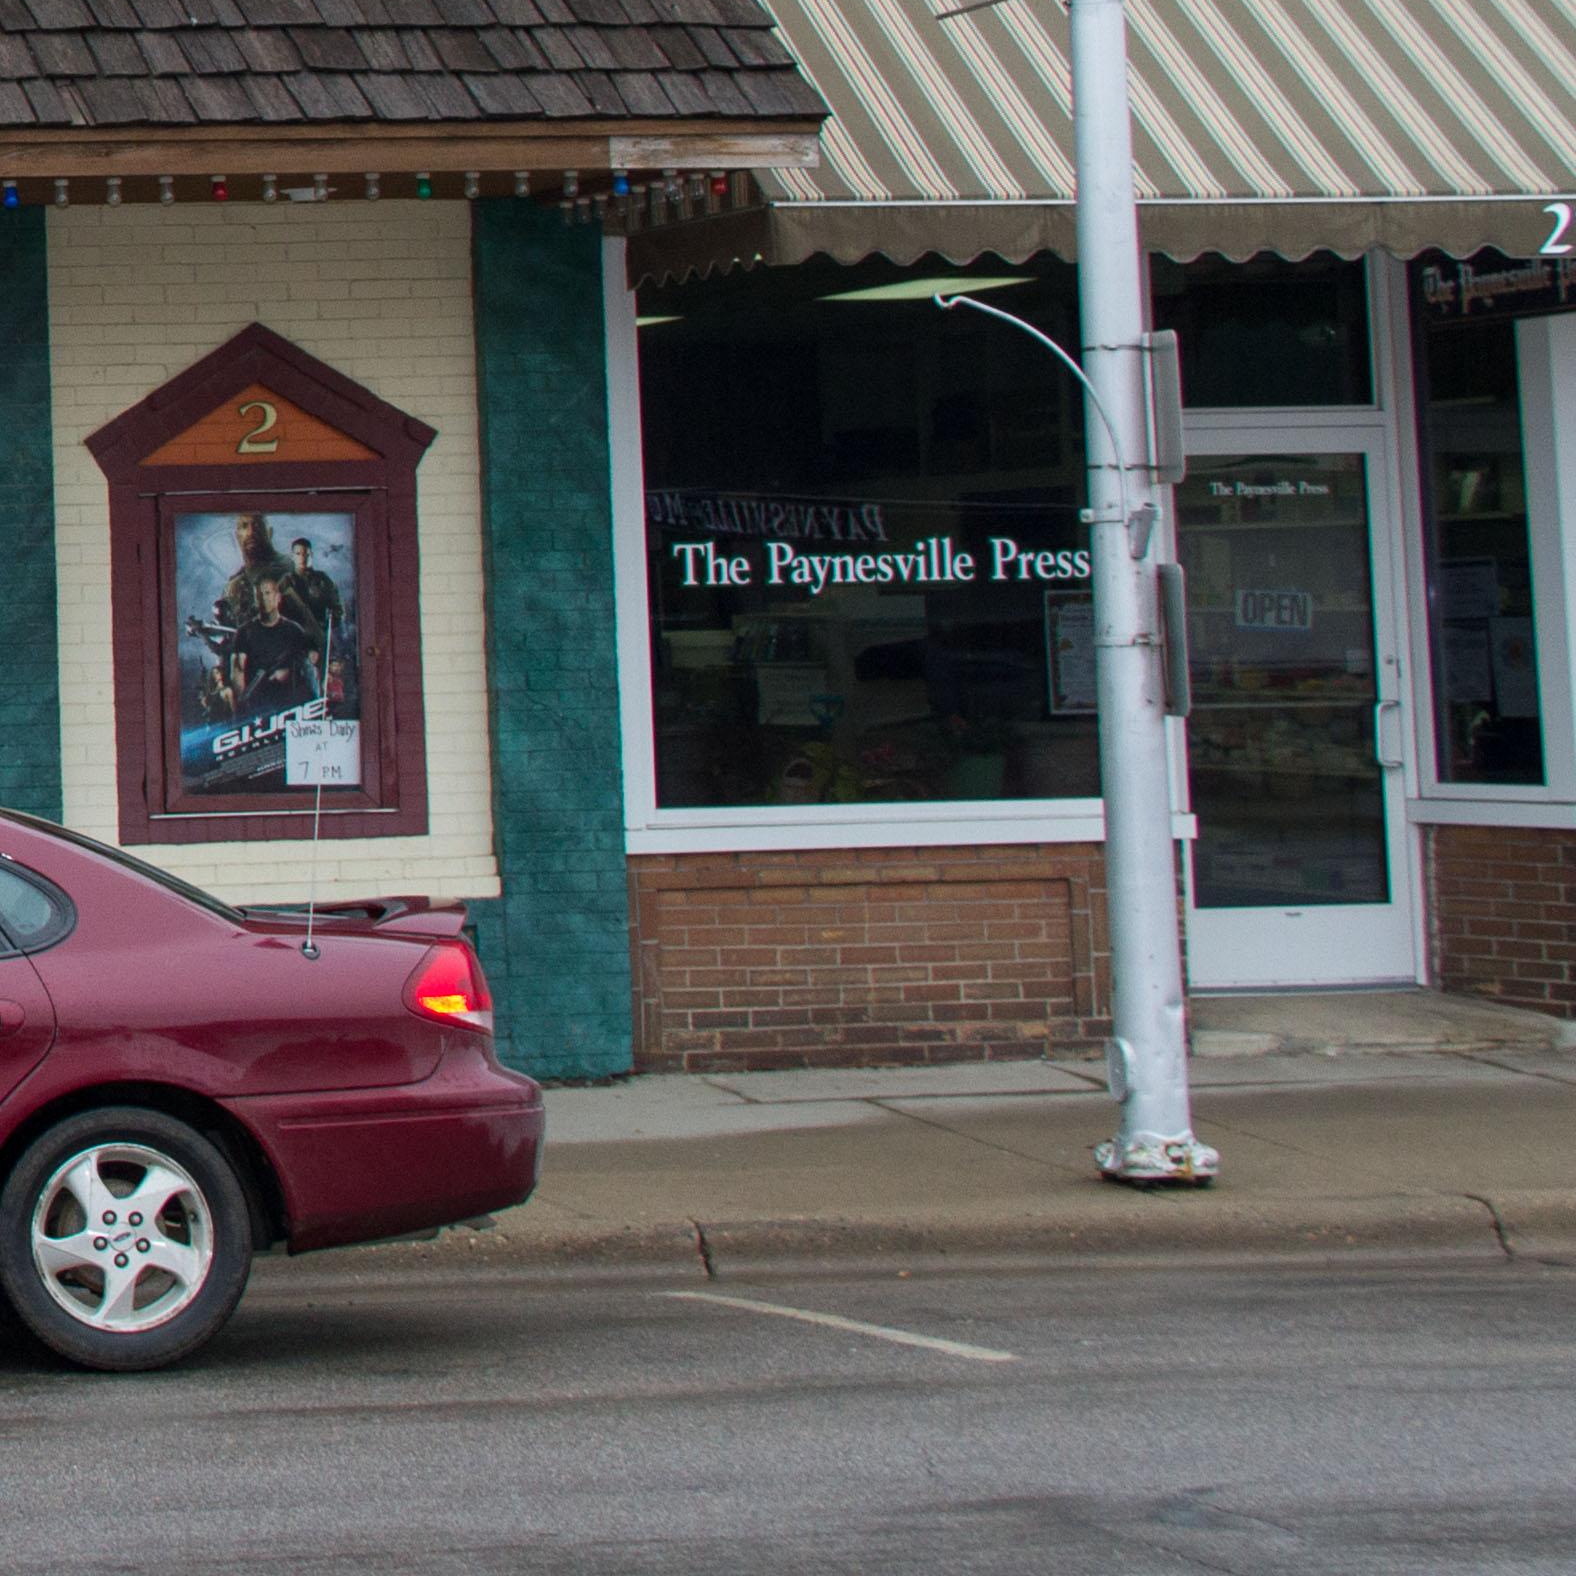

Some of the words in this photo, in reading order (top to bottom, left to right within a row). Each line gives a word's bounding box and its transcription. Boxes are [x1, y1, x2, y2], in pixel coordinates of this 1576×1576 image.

[236, 400, 282, 455] 2
[1209, 481, 1234, 496] The
[1299, 480, 1331, 495] Press
[672, 540, 751, 586] The
[766, 536, 976, 595] Paynesville
[990, 537, 1091, 581] Press
[1241, 592, 1307, 627] OPEN
[299, 761, 310, 779] 7
